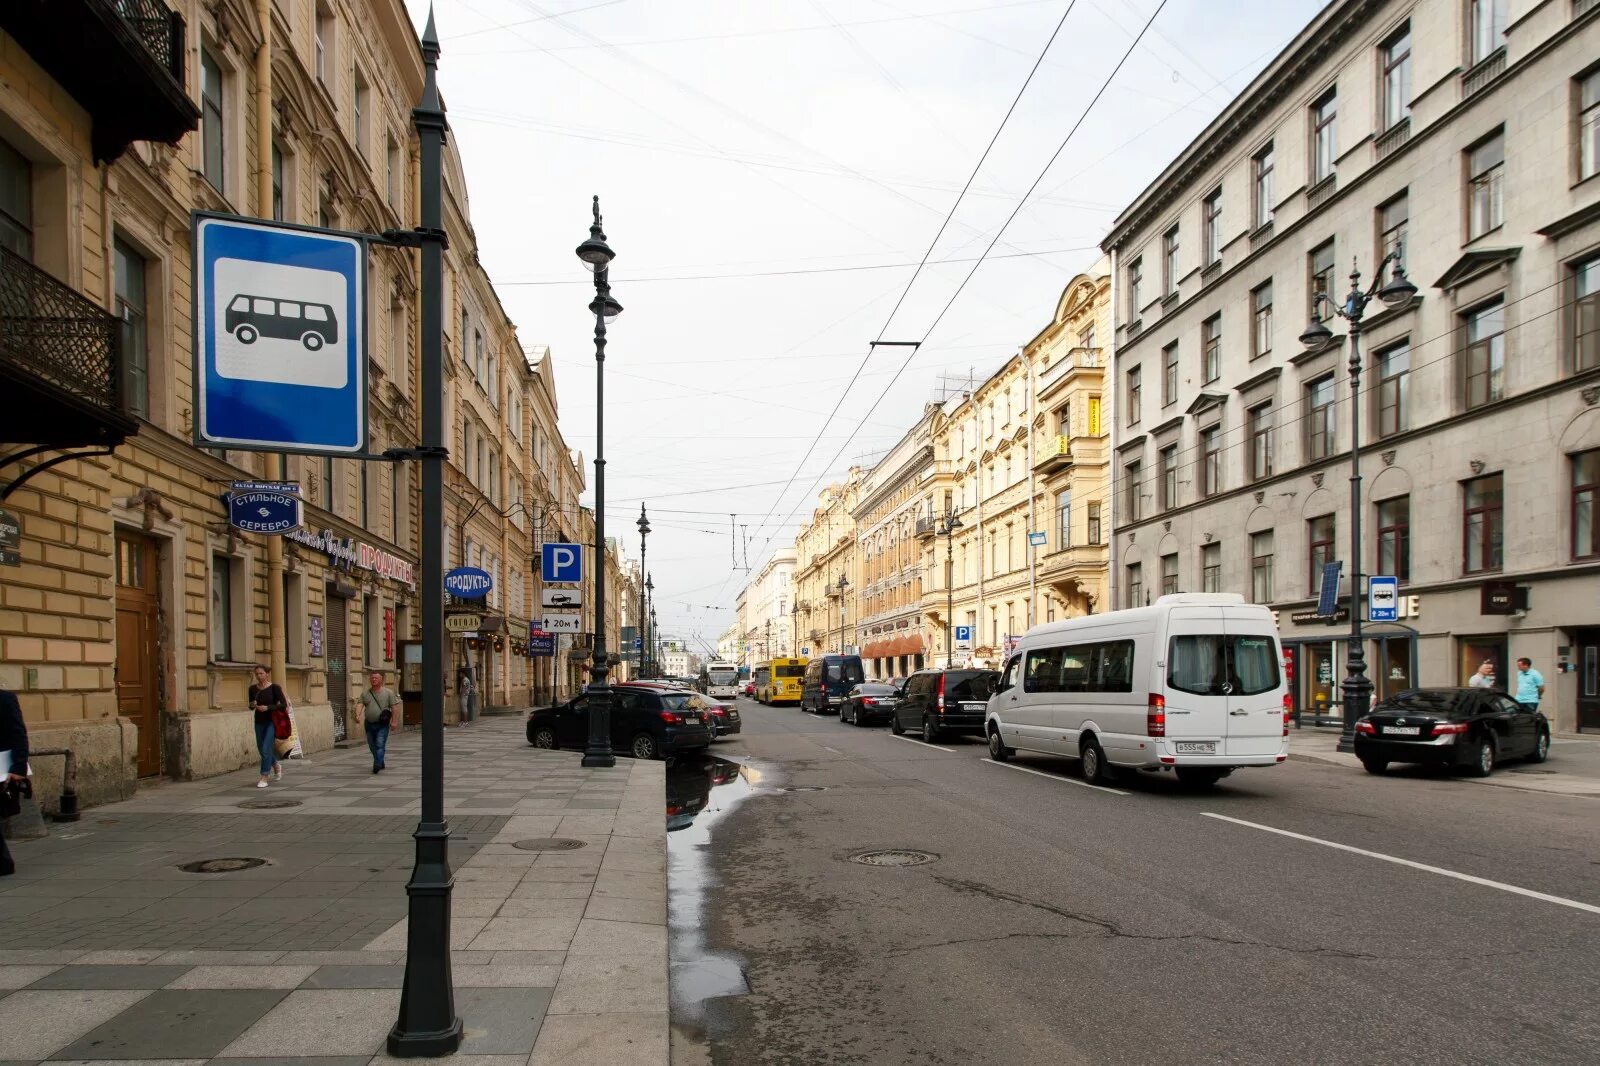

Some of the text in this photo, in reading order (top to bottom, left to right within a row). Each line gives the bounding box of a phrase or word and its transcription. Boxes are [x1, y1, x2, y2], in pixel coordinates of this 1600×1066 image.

[236, 494, 292, 506] СТИЛЬНОЕ
[240, 519, 290, 531] СЕРЕБРО
[360, 542, 413, 584] ПРОДУКТЫ
[553, 547, 575, 578] P
[446, 574, 490, 592] ПРОДУКТЫ
[448, 617, 479, 627] ГОГОЛЬ
[553, 619, 571, 628] 20м
[959, 627, 967, 639] P
